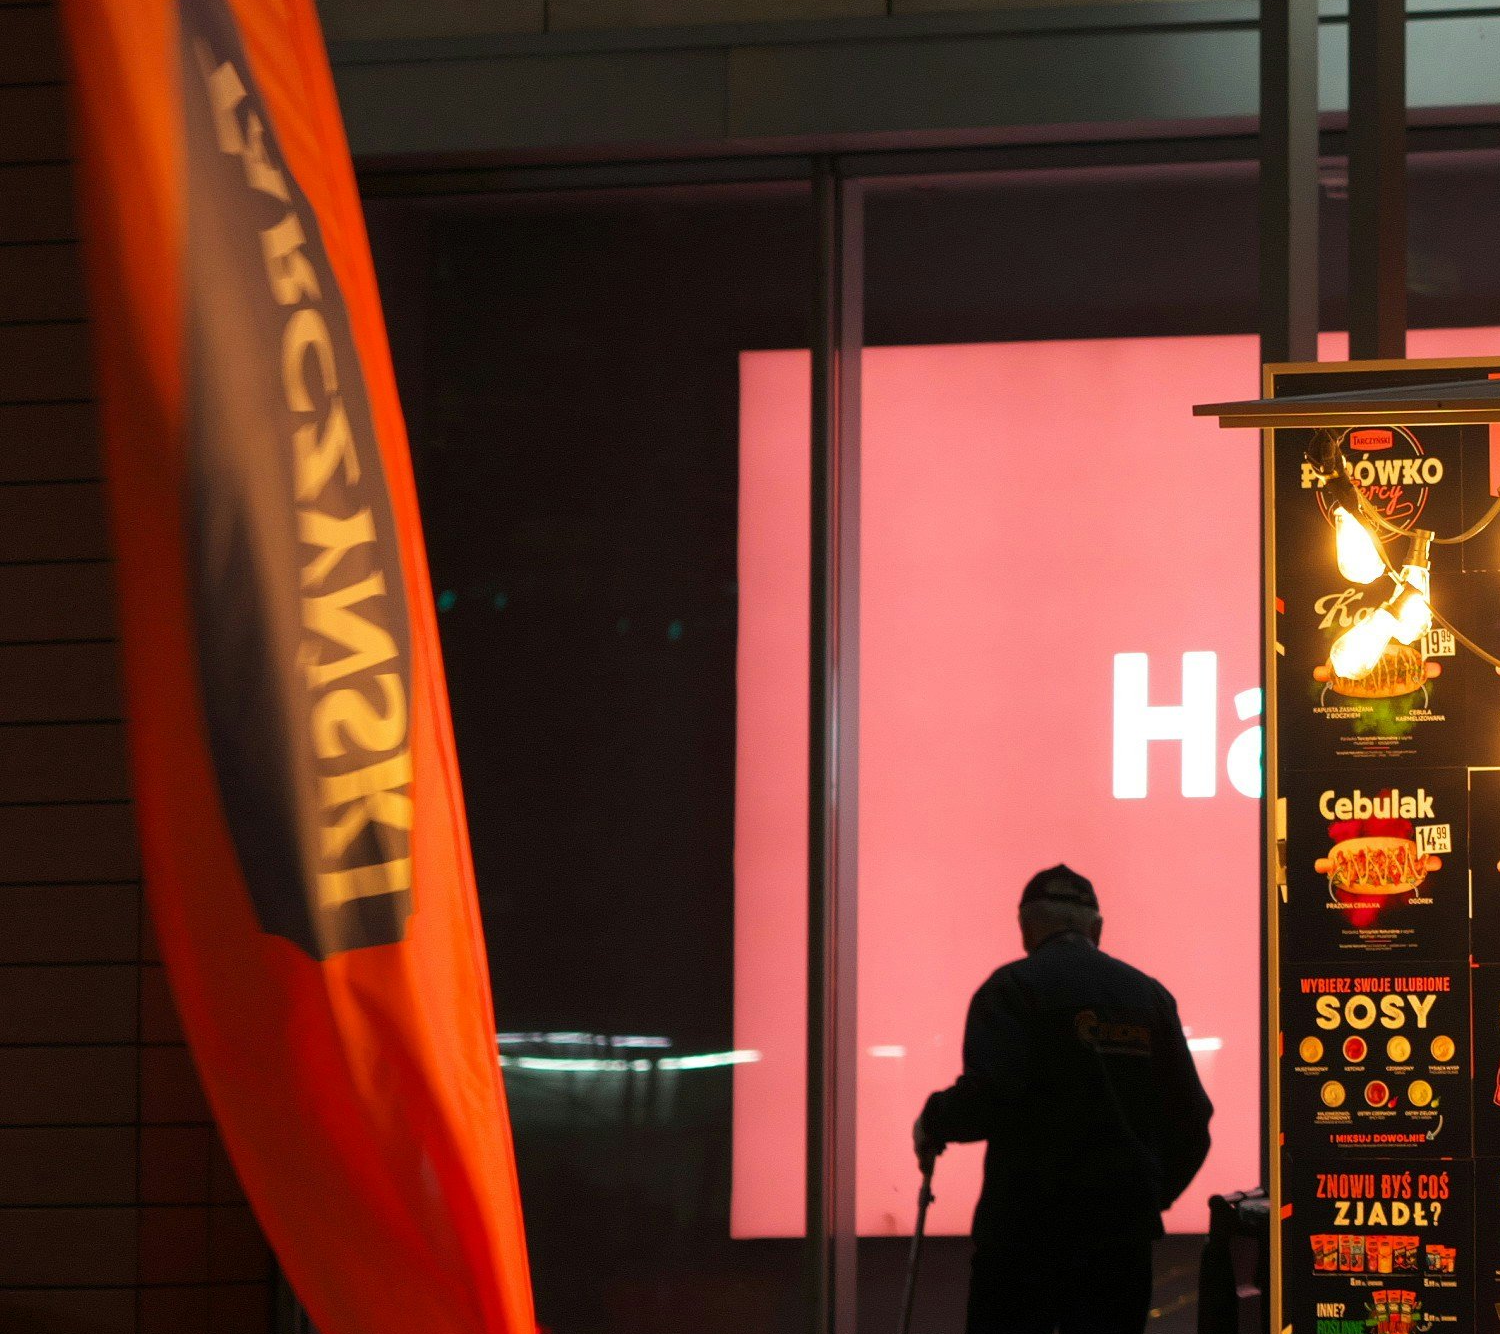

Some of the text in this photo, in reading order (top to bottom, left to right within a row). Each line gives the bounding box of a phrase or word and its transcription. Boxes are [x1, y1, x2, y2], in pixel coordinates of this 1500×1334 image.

[1353, 435, 1391, 446] TARCZYŃSKI
[1319, 788, 1435, 820] Cebulak
[1419, 826, 1447, 852] 14 99
[1408, 897, 1434, 905] OGÓREK
[1301, 977, 1450, 993] WYBIERZ SWOJE ULUBIONE
[1316, 994, 1437, 1030] SOSY
[1336, 1134, 1426, 1143] MIKSUJ DOWOLNIE
[1316, 1171, 1449, 1199] ZNOWU BYŚ COŚ
[1333, 1201, 1442, 1226] ZJADŁ?
[1317, 1303, 1346, 1318] INNE?
